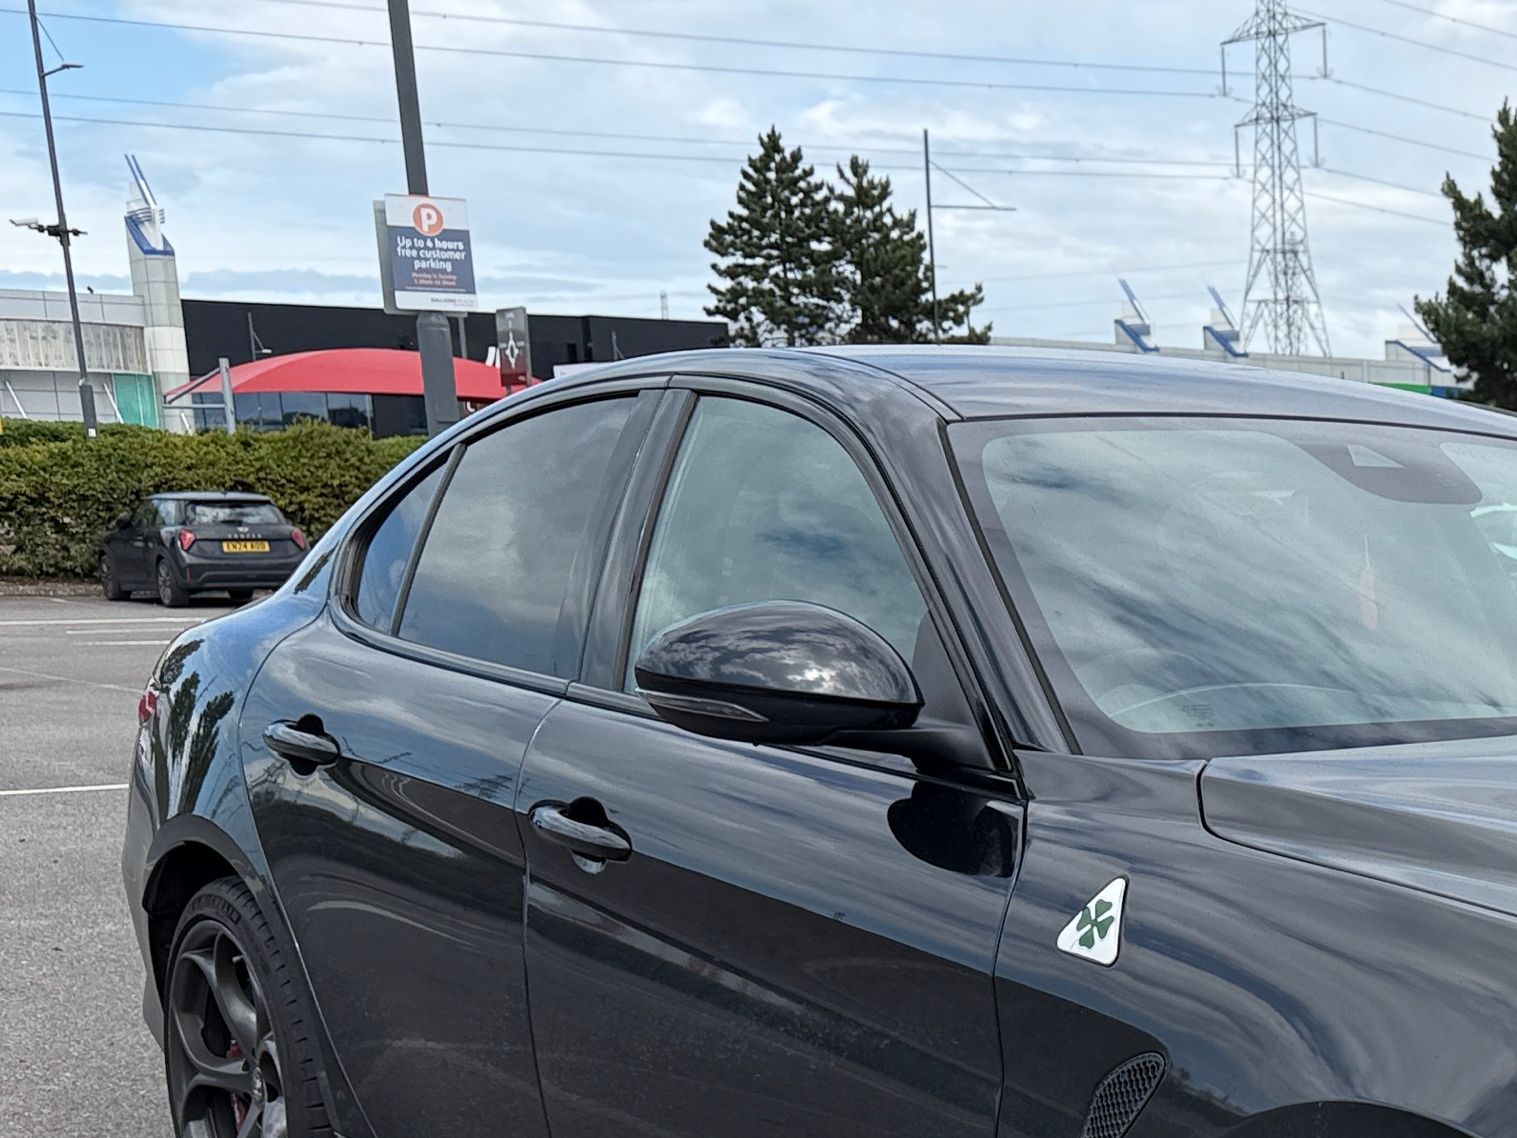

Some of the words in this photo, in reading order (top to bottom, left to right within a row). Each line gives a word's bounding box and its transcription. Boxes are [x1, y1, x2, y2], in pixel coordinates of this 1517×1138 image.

[419, 207, 438, 232] P
[397, 235, 412, 249] Up
[413, 237, 425, 248] to
[426, 238, 434, 248] 4
[434, 238, 464, 250] hours
[396, 246, 418, 257] free
[419, 249, 466, 260] customer
[413, 259, 453, 272] parking
